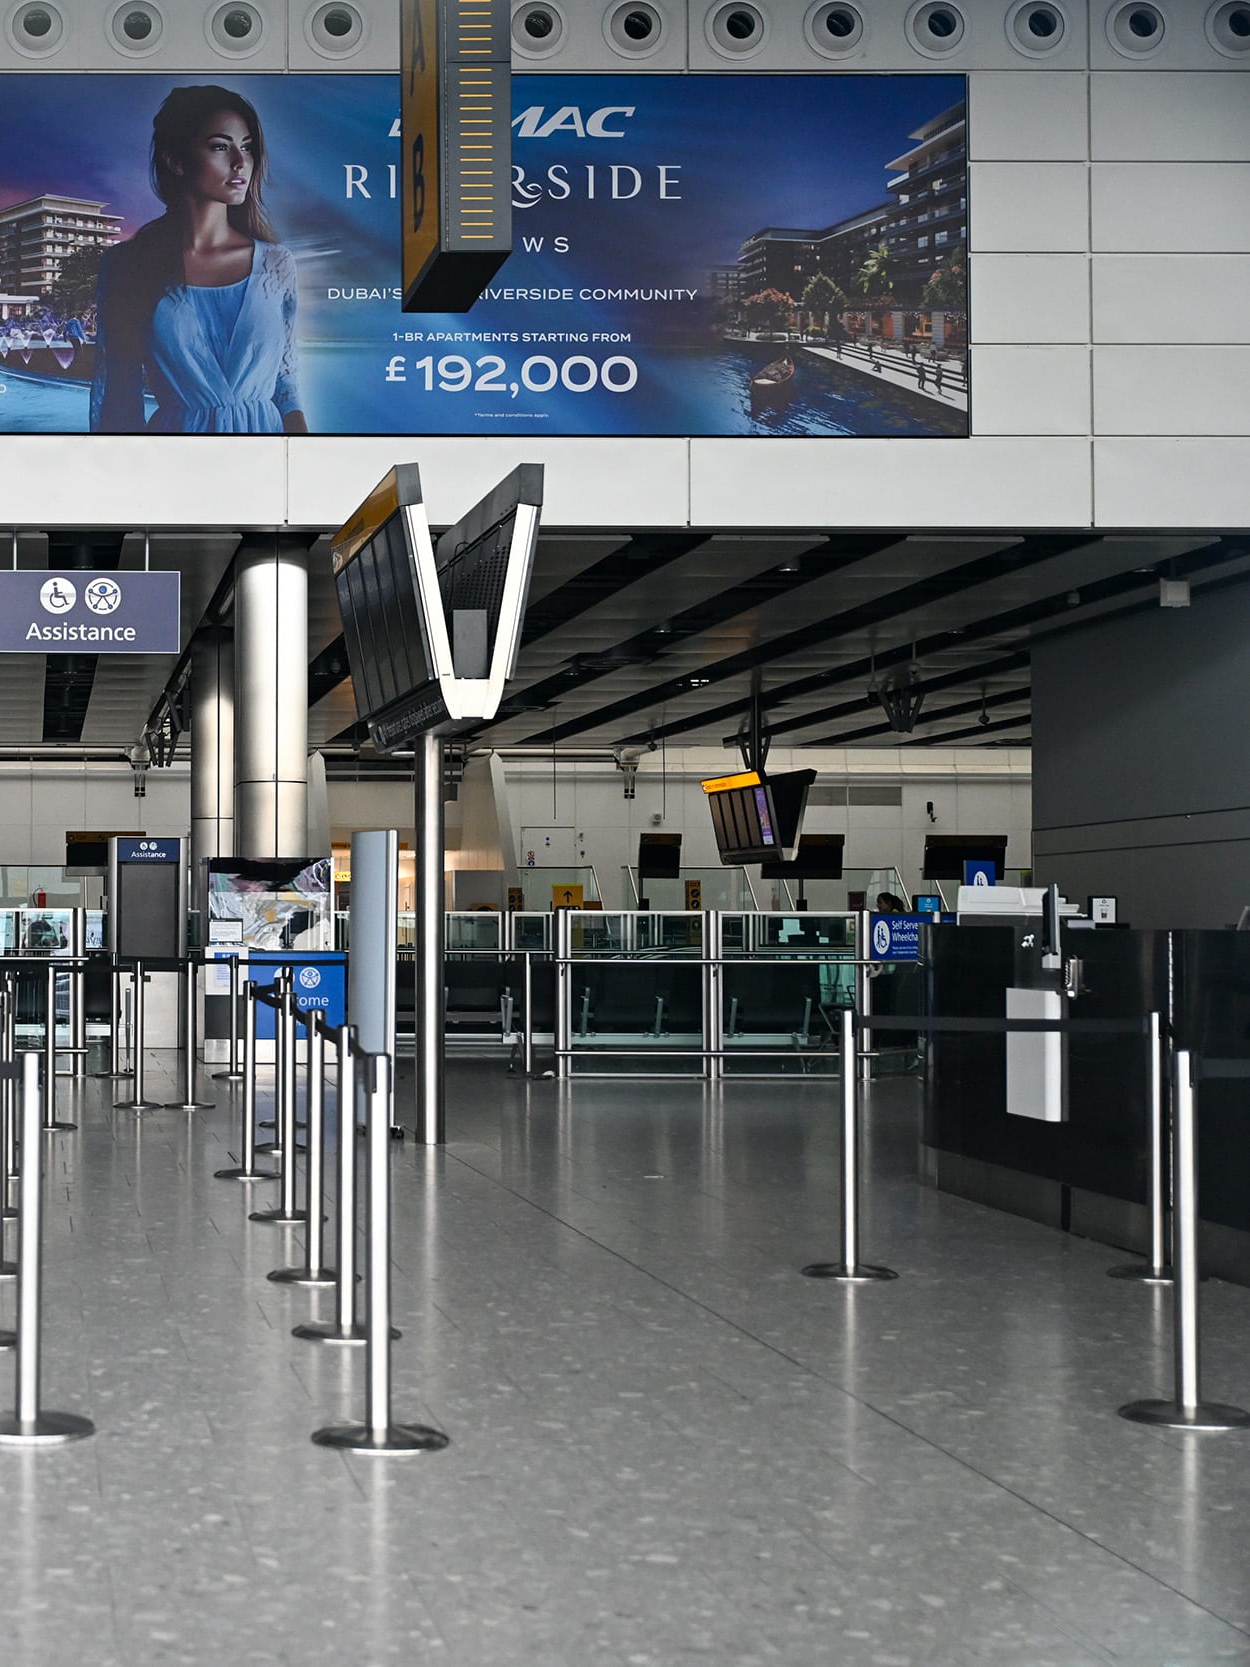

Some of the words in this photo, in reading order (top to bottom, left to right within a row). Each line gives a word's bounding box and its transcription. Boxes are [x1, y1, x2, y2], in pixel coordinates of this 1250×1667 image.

[388, 106, 636, 138] MAC
[343, 164, 682, 209] RIRSIDE
[412, 133, 426, 234] B
[578, 287, 698, 301] COMMUNITY
[392, 332, 424, 342] 1-BR
[426, 332, 520, 343] APARTMENTS
[521, 332, 589, 343] STARTING
[591, 332, 632, 343] FROM
[25, 622, 137, 641] Assistance
[891, 920, 903, 930] Self
[891, 931, 919, 942] Wheelcha
